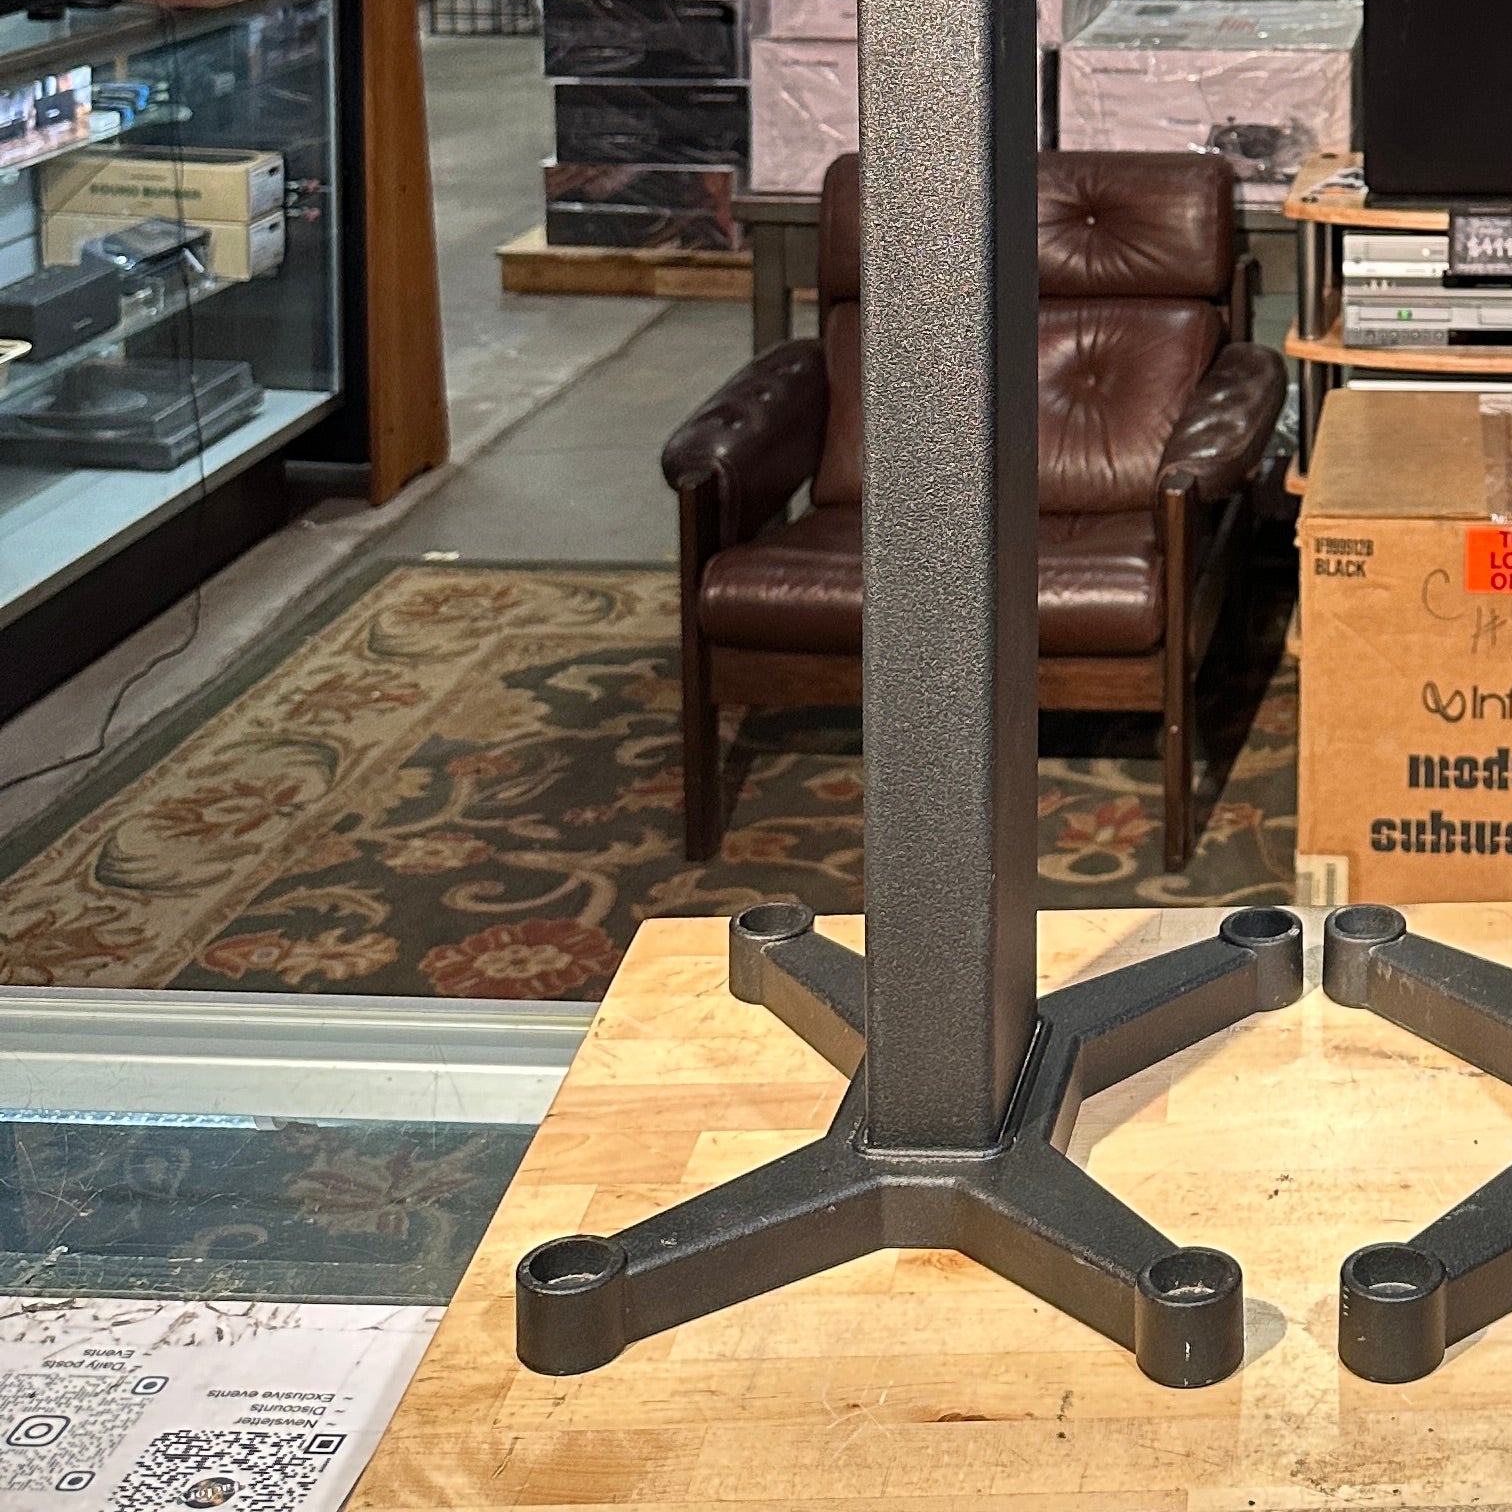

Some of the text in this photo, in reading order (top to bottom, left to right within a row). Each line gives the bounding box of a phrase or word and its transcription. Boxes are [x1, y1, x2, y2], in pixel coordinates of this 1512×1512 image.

[1313, 557, 1367, 578] BLACK
[82, 1349, 136, 1359] Events
[41, 1359, 126, 1371] Daily posts
[206, 1389, 337, 1403] Exclusive events
[250, 1403, 328, 1416] Discounts
[233, 1416, 319, 1429] Newsletter
